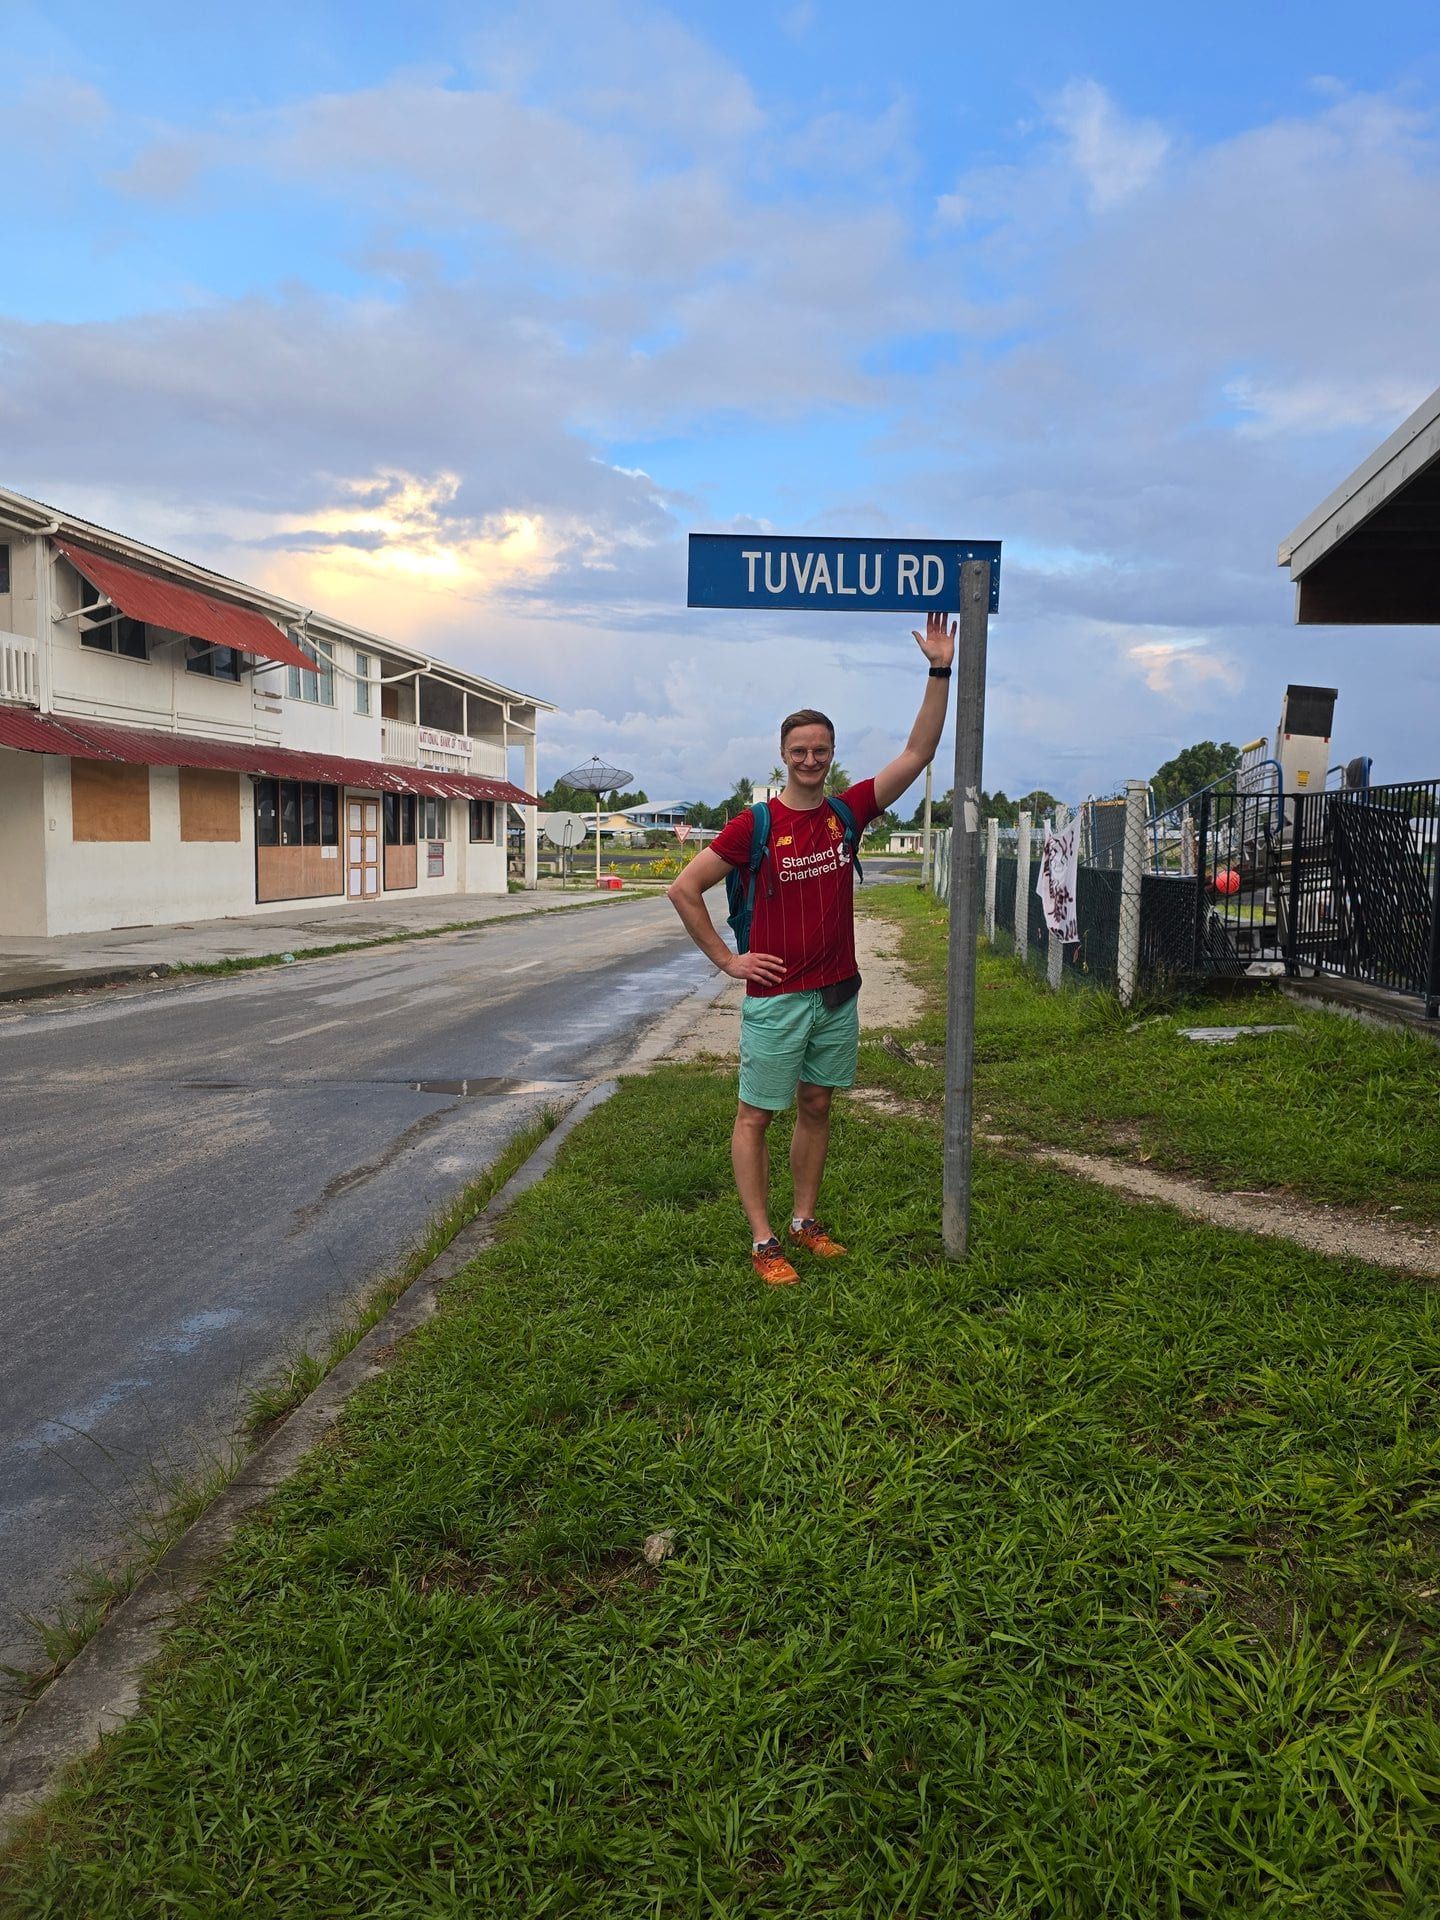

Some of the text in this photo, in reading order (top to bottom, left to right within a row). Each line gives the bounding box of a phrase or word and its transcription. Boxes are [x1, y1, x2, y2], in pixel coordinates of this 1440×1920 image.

[742, 551, 945, 596] TUVALU RD
[782, 846, 835, 868] Standard
[779, 859, 837, 882] Chartered
